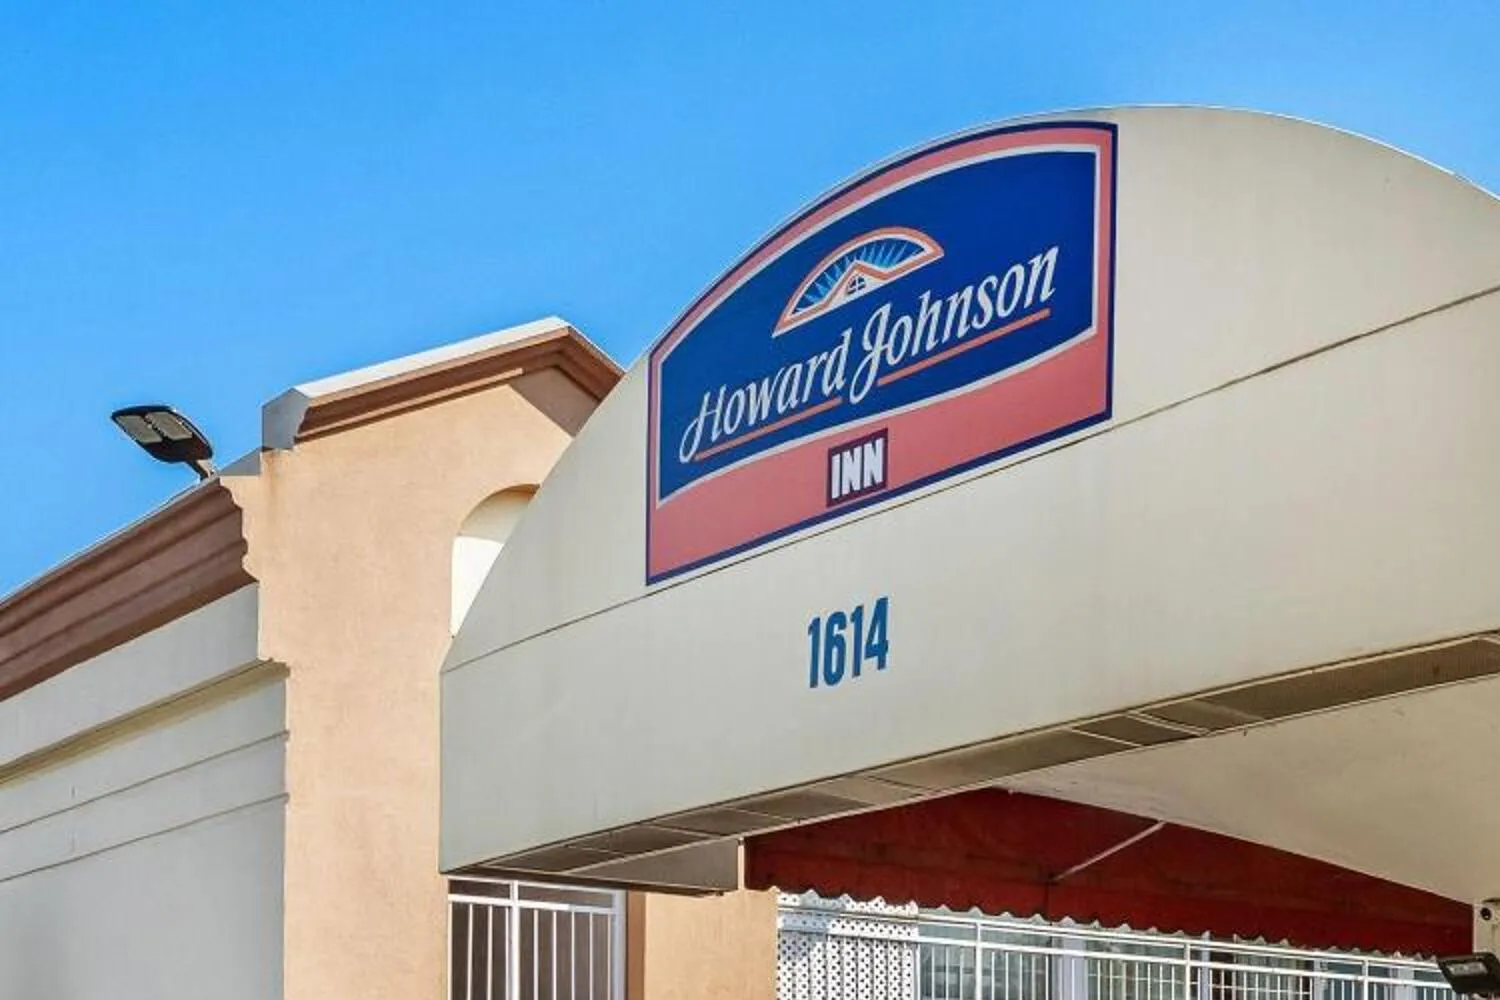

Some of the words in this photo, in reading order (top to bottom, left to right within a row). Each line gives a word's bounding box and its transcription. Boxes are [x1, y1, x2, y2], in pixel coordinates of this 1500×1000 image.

[678, 332, 850, 464] Howard
[850, 245, 1060, 404] Johnson
[831, 439, 884, 499] INN
[808, 596, 889, 688] 1614
